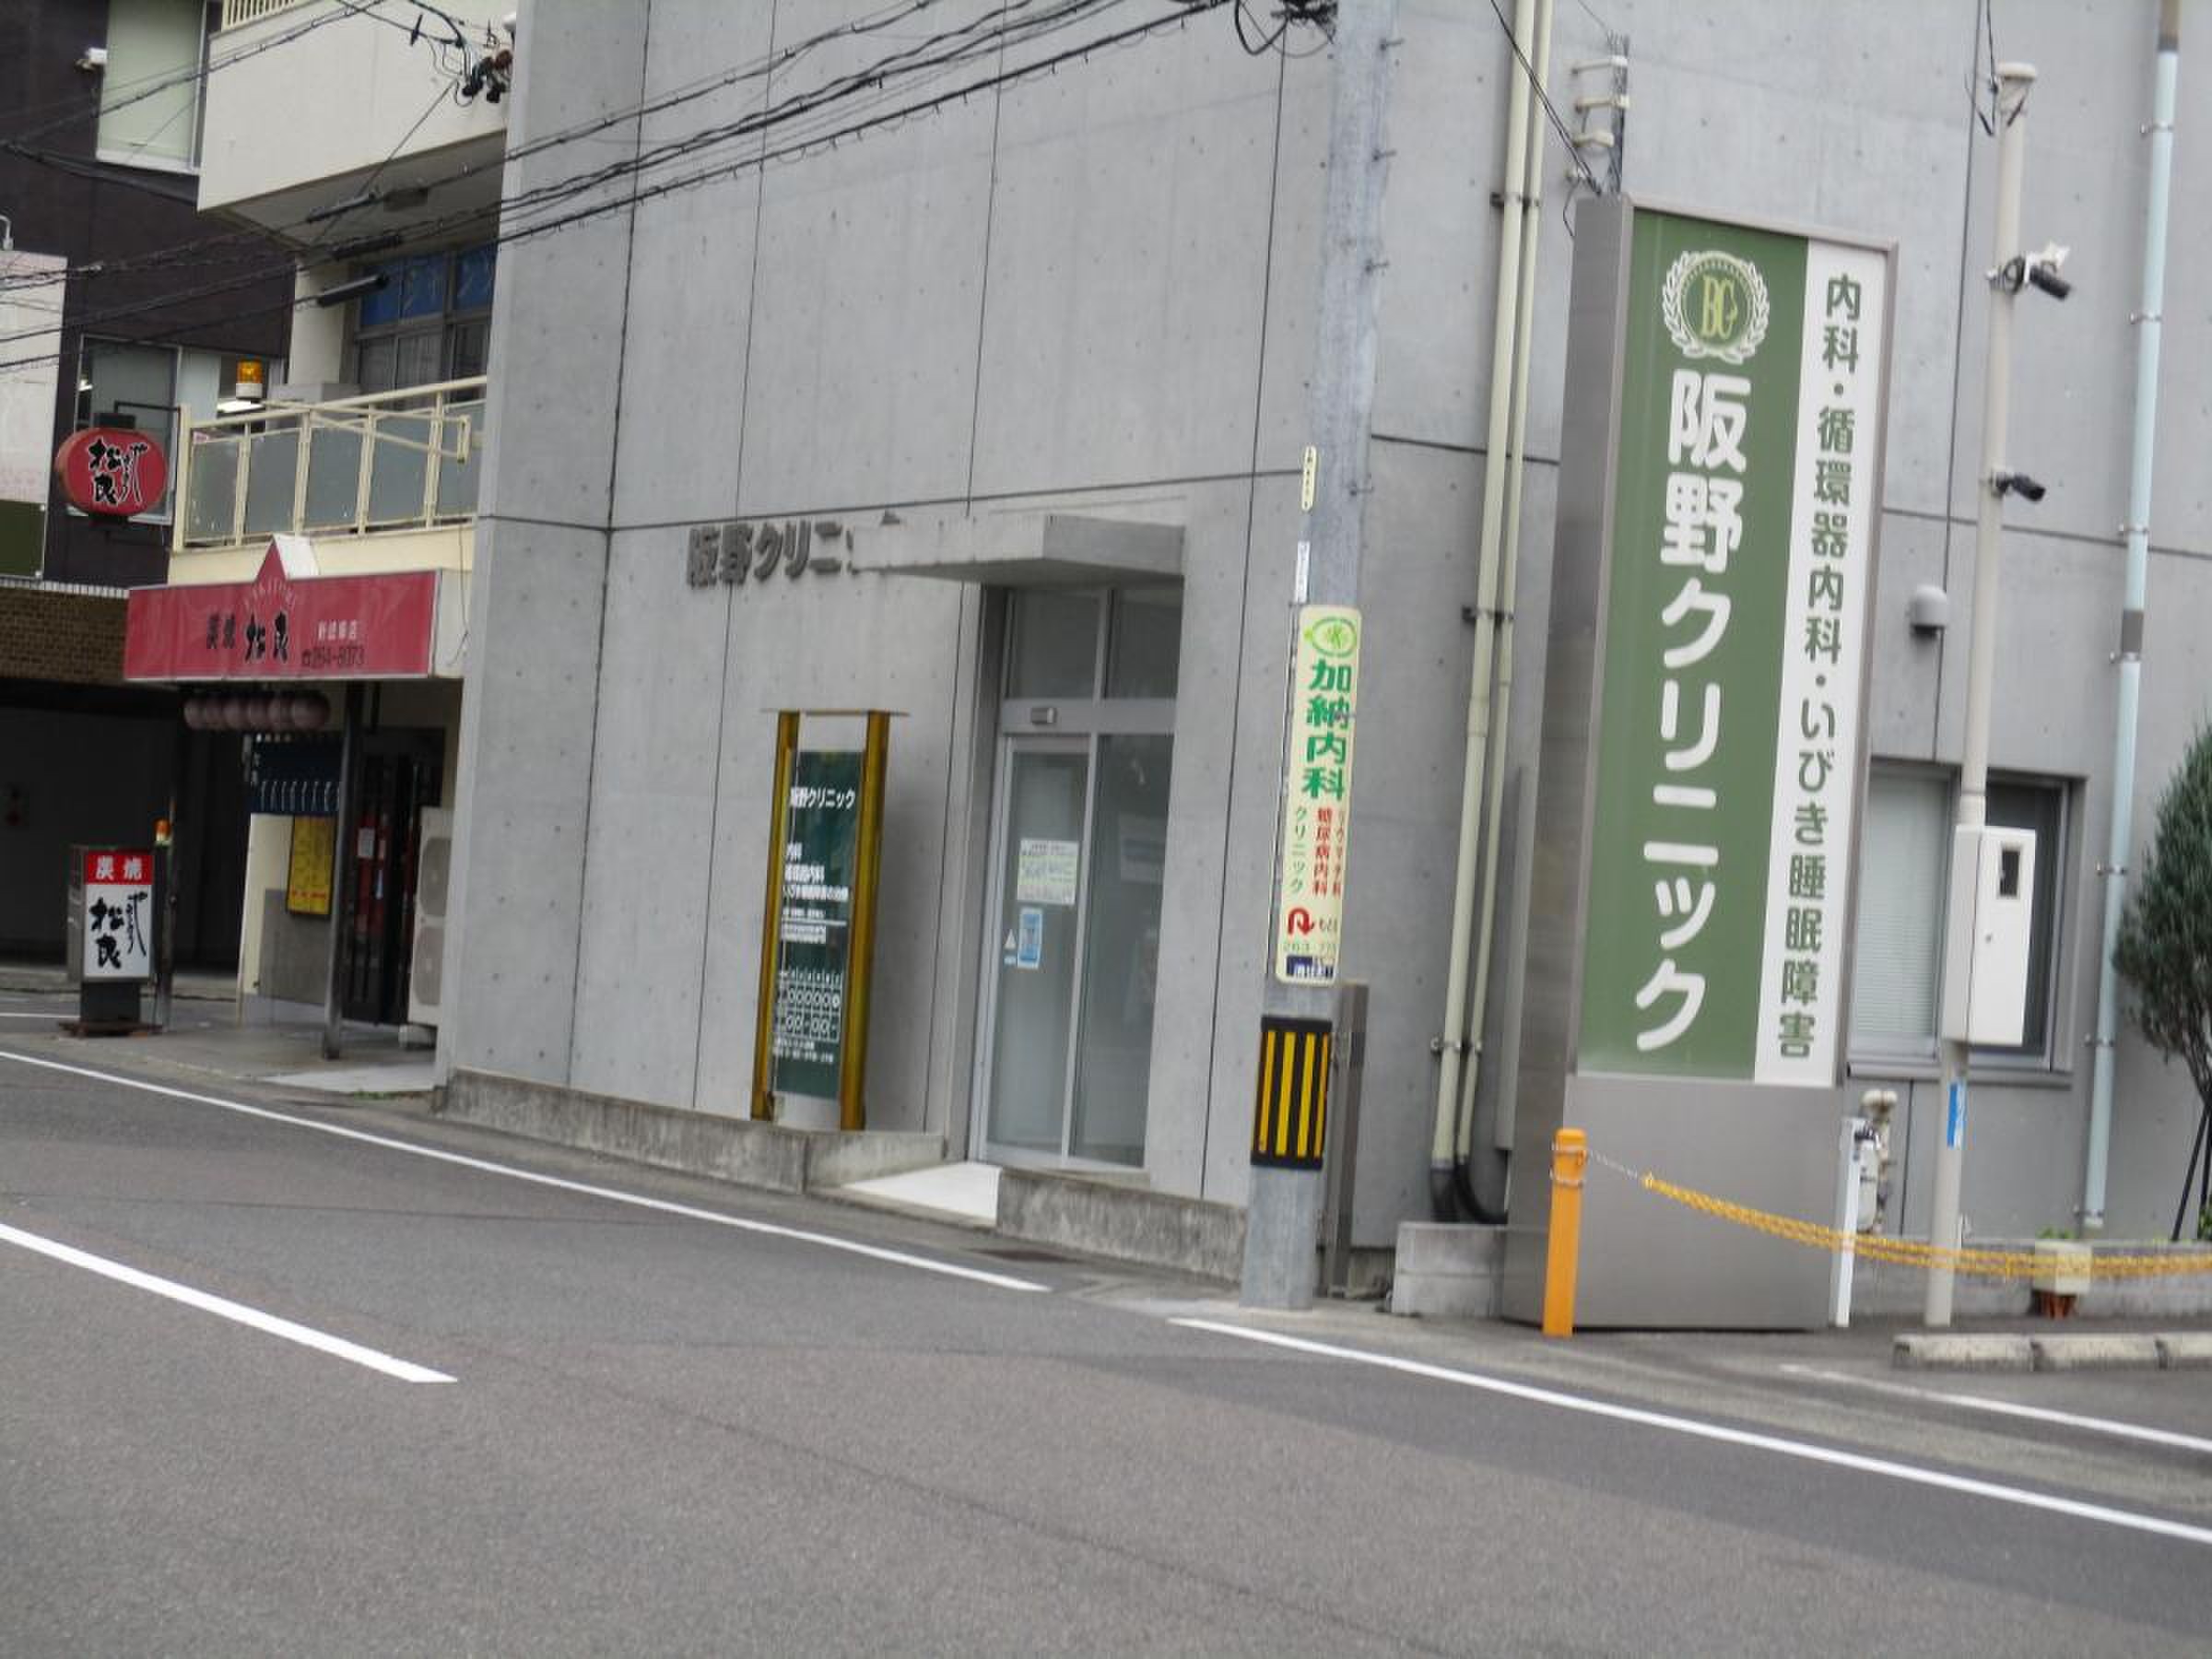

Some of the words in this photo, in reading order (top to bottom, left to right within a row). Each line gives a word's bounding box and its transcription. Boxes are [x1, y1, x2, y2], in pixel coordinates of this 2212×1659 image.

[687, 518, 855, 589] 阪野クリニ
[1300, 658, 1352, 801] 加納内科
[1636, 369, 1752, 1052] 阪野クリニック
